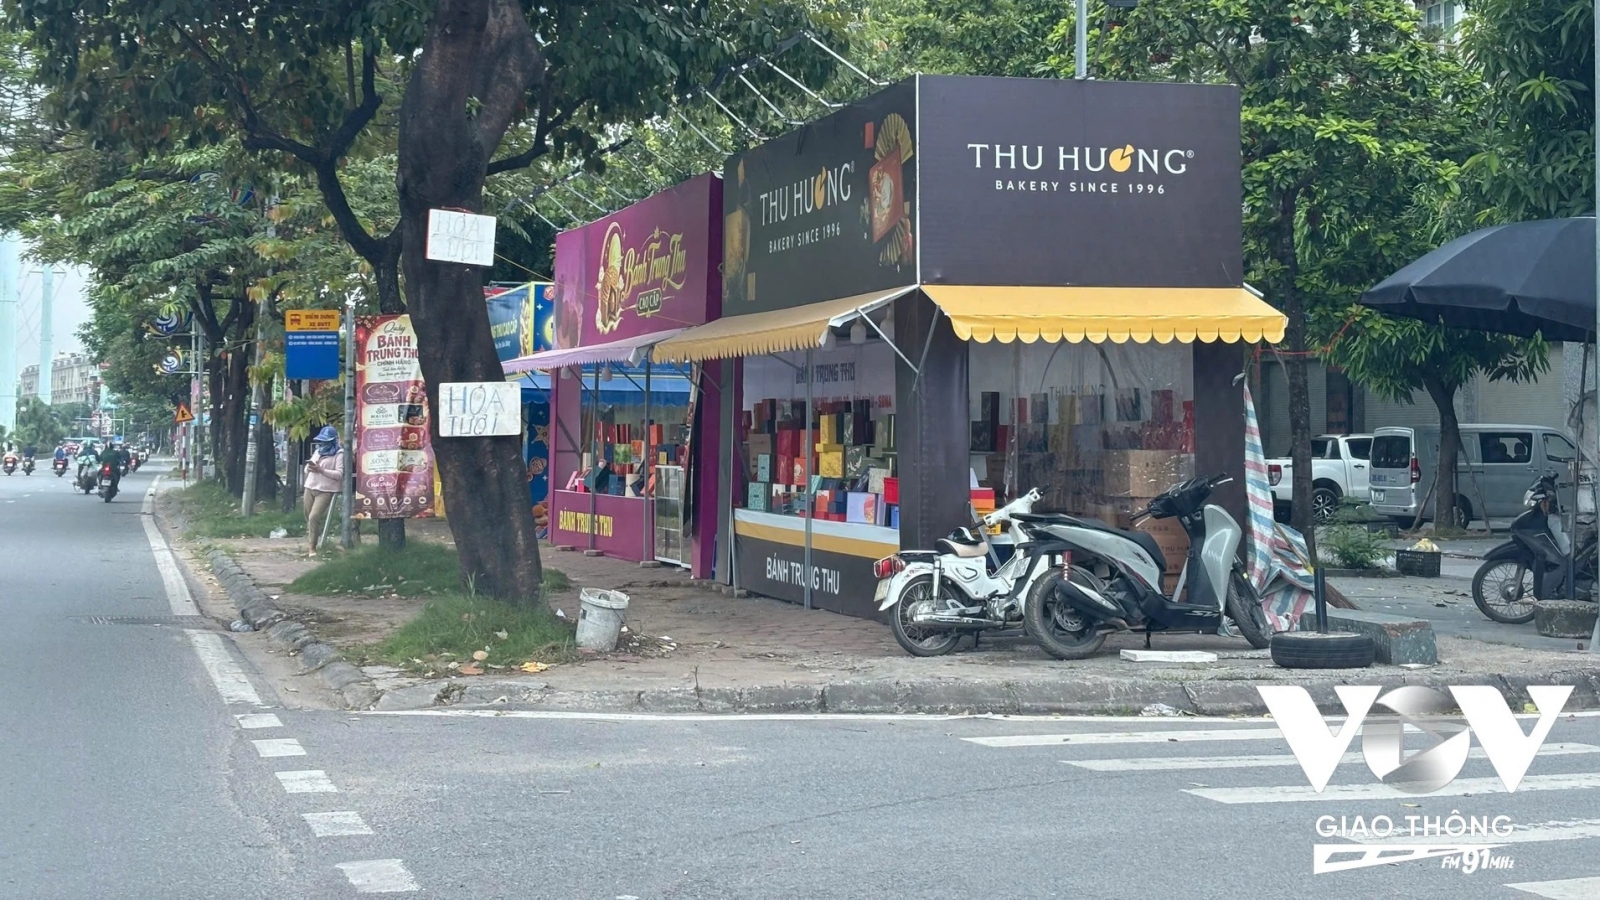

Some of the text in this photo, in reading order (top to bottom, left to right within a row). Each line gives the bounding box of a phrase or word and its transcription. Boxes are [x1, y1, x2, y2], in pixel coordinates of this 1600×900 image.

[967, 143, 1043, 170] THU
[995, 180, 1165, 194] BAKERY SINCE 1996
[760, 185, 789, 226] THU
[769, 221, 841, 254] BAKERY SINCE 1996
[621, 231, 687, 302] Bánh Trung Thu
[639, 296, 649, 310] CAO
[366, 347, 400, 363] TRUNG
[377, 333, 411, 349] BÁNH
[449, 385, 505, 415] HOA
[558, 506, 576, 532] BÁNH
[599, 514, 613, 538] THU
[766, 552, 789, 583] BÁNH
[821, 567, 840, 595] THU
